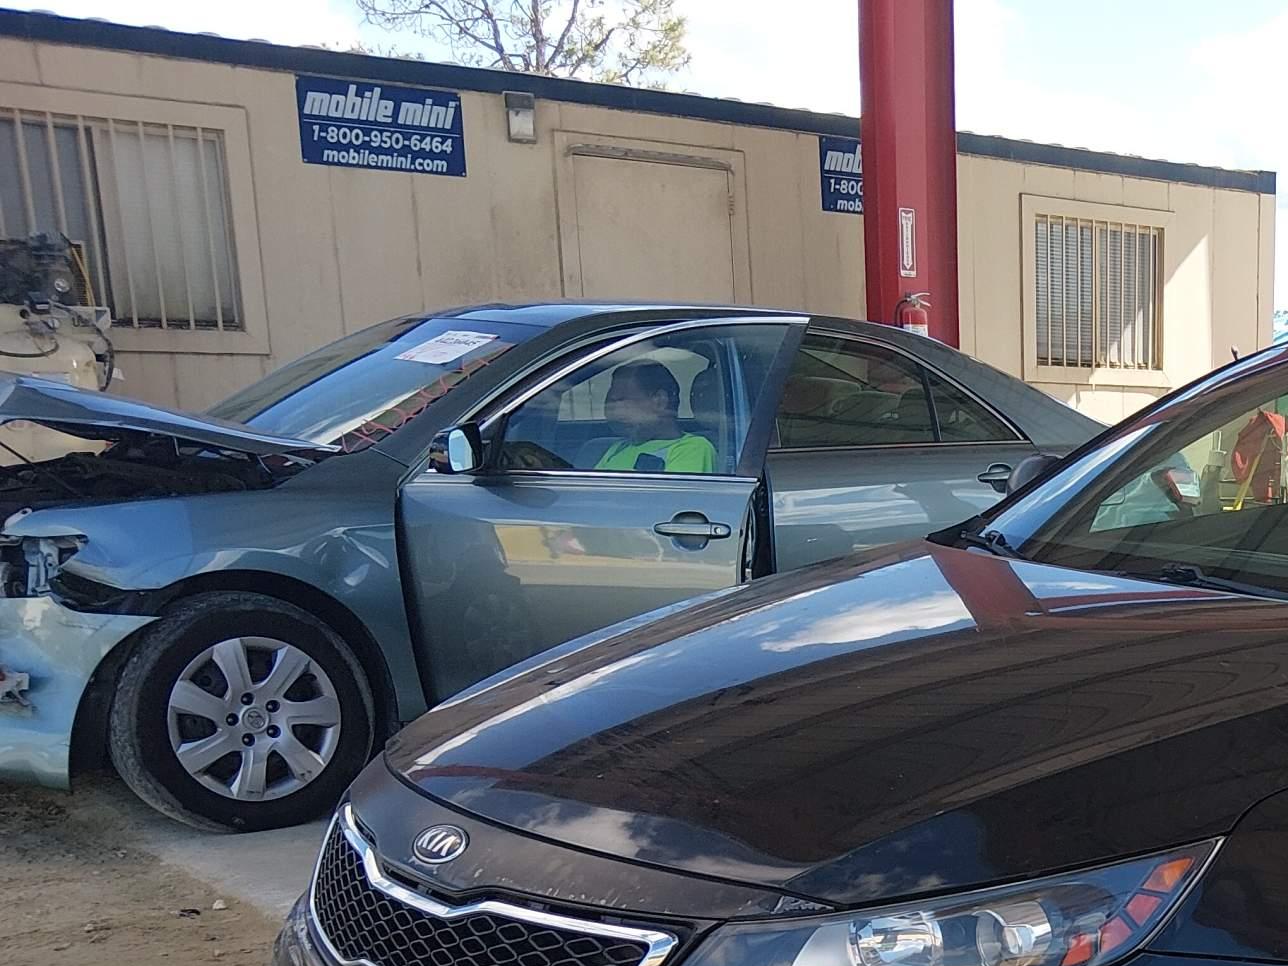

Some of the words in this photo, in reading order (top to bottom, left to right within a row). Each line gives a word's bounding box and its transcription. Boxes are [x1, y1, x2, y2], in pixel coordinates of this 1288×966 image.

[304, 84, 394, 123] mobile
[397, 98, 456, 129] mini
[312, 124, 453, 154] 1-800-950-6464
[322, 148, 448, 172] mobilemini.com
